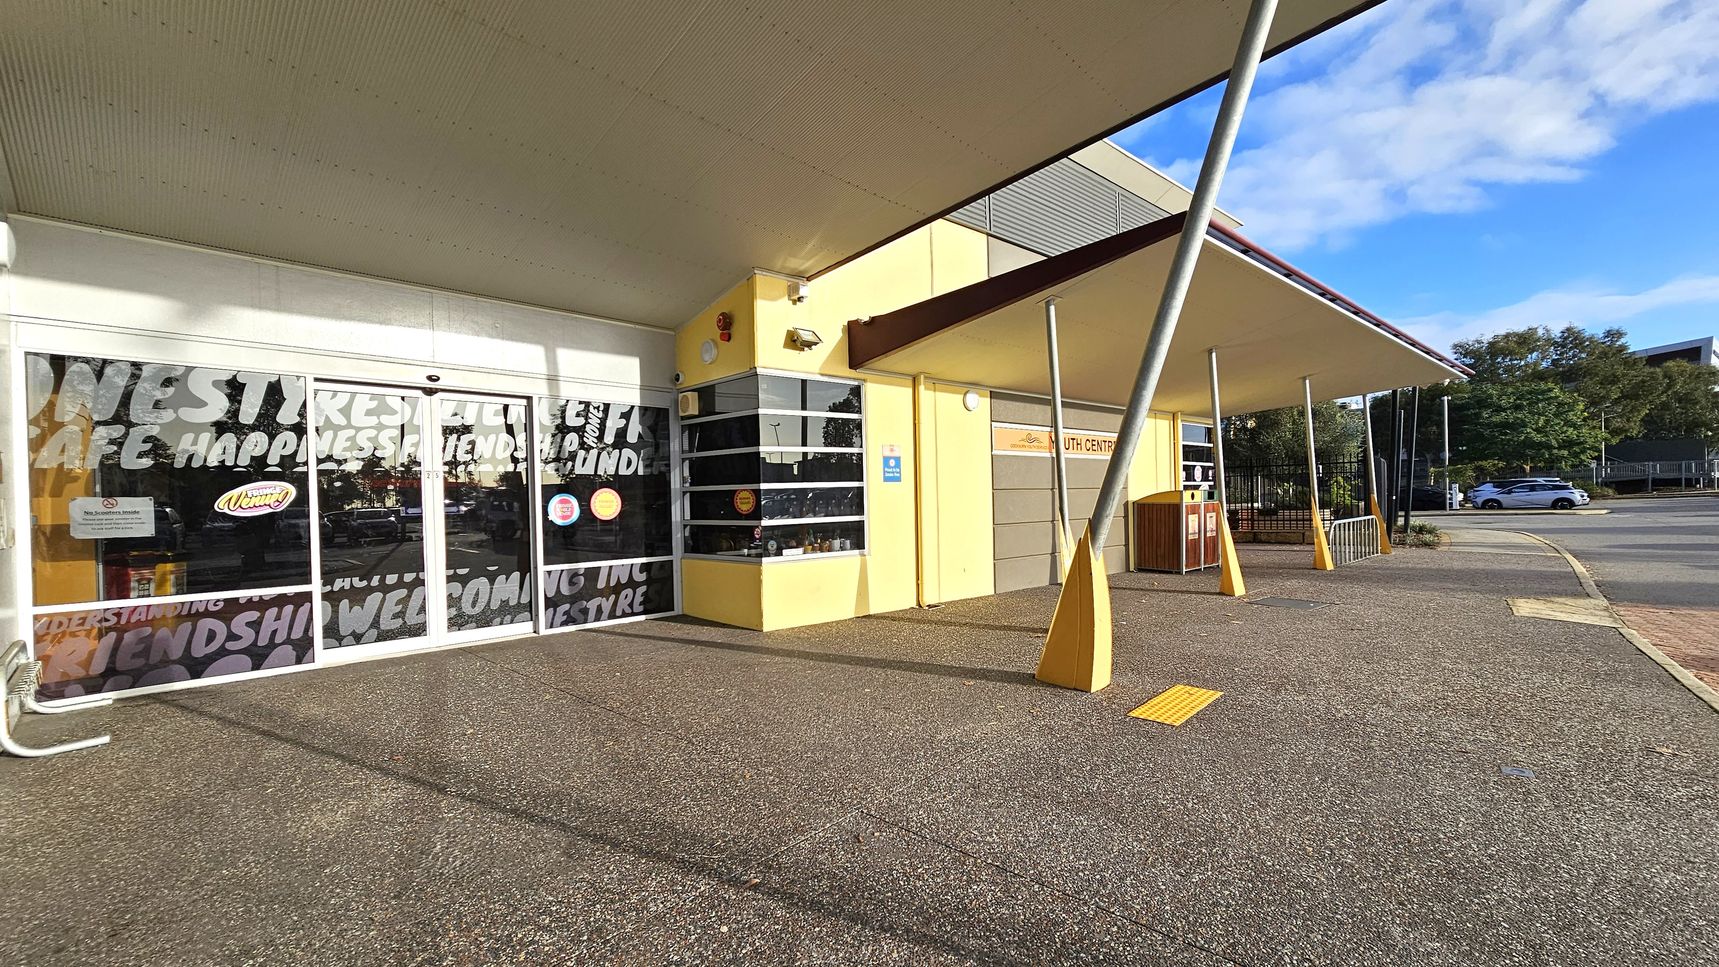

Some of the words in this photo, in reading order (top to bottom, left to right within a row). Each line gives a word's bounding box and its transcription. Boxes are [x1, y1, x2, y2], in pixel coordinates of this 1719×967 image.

[28, 424, 160, 470] AFE
[400, 432, 580, 463] FIENDSHIP
[1049, 435, 1083, 451] YUTH
[1084, 438, 1117, 452] CENTR
